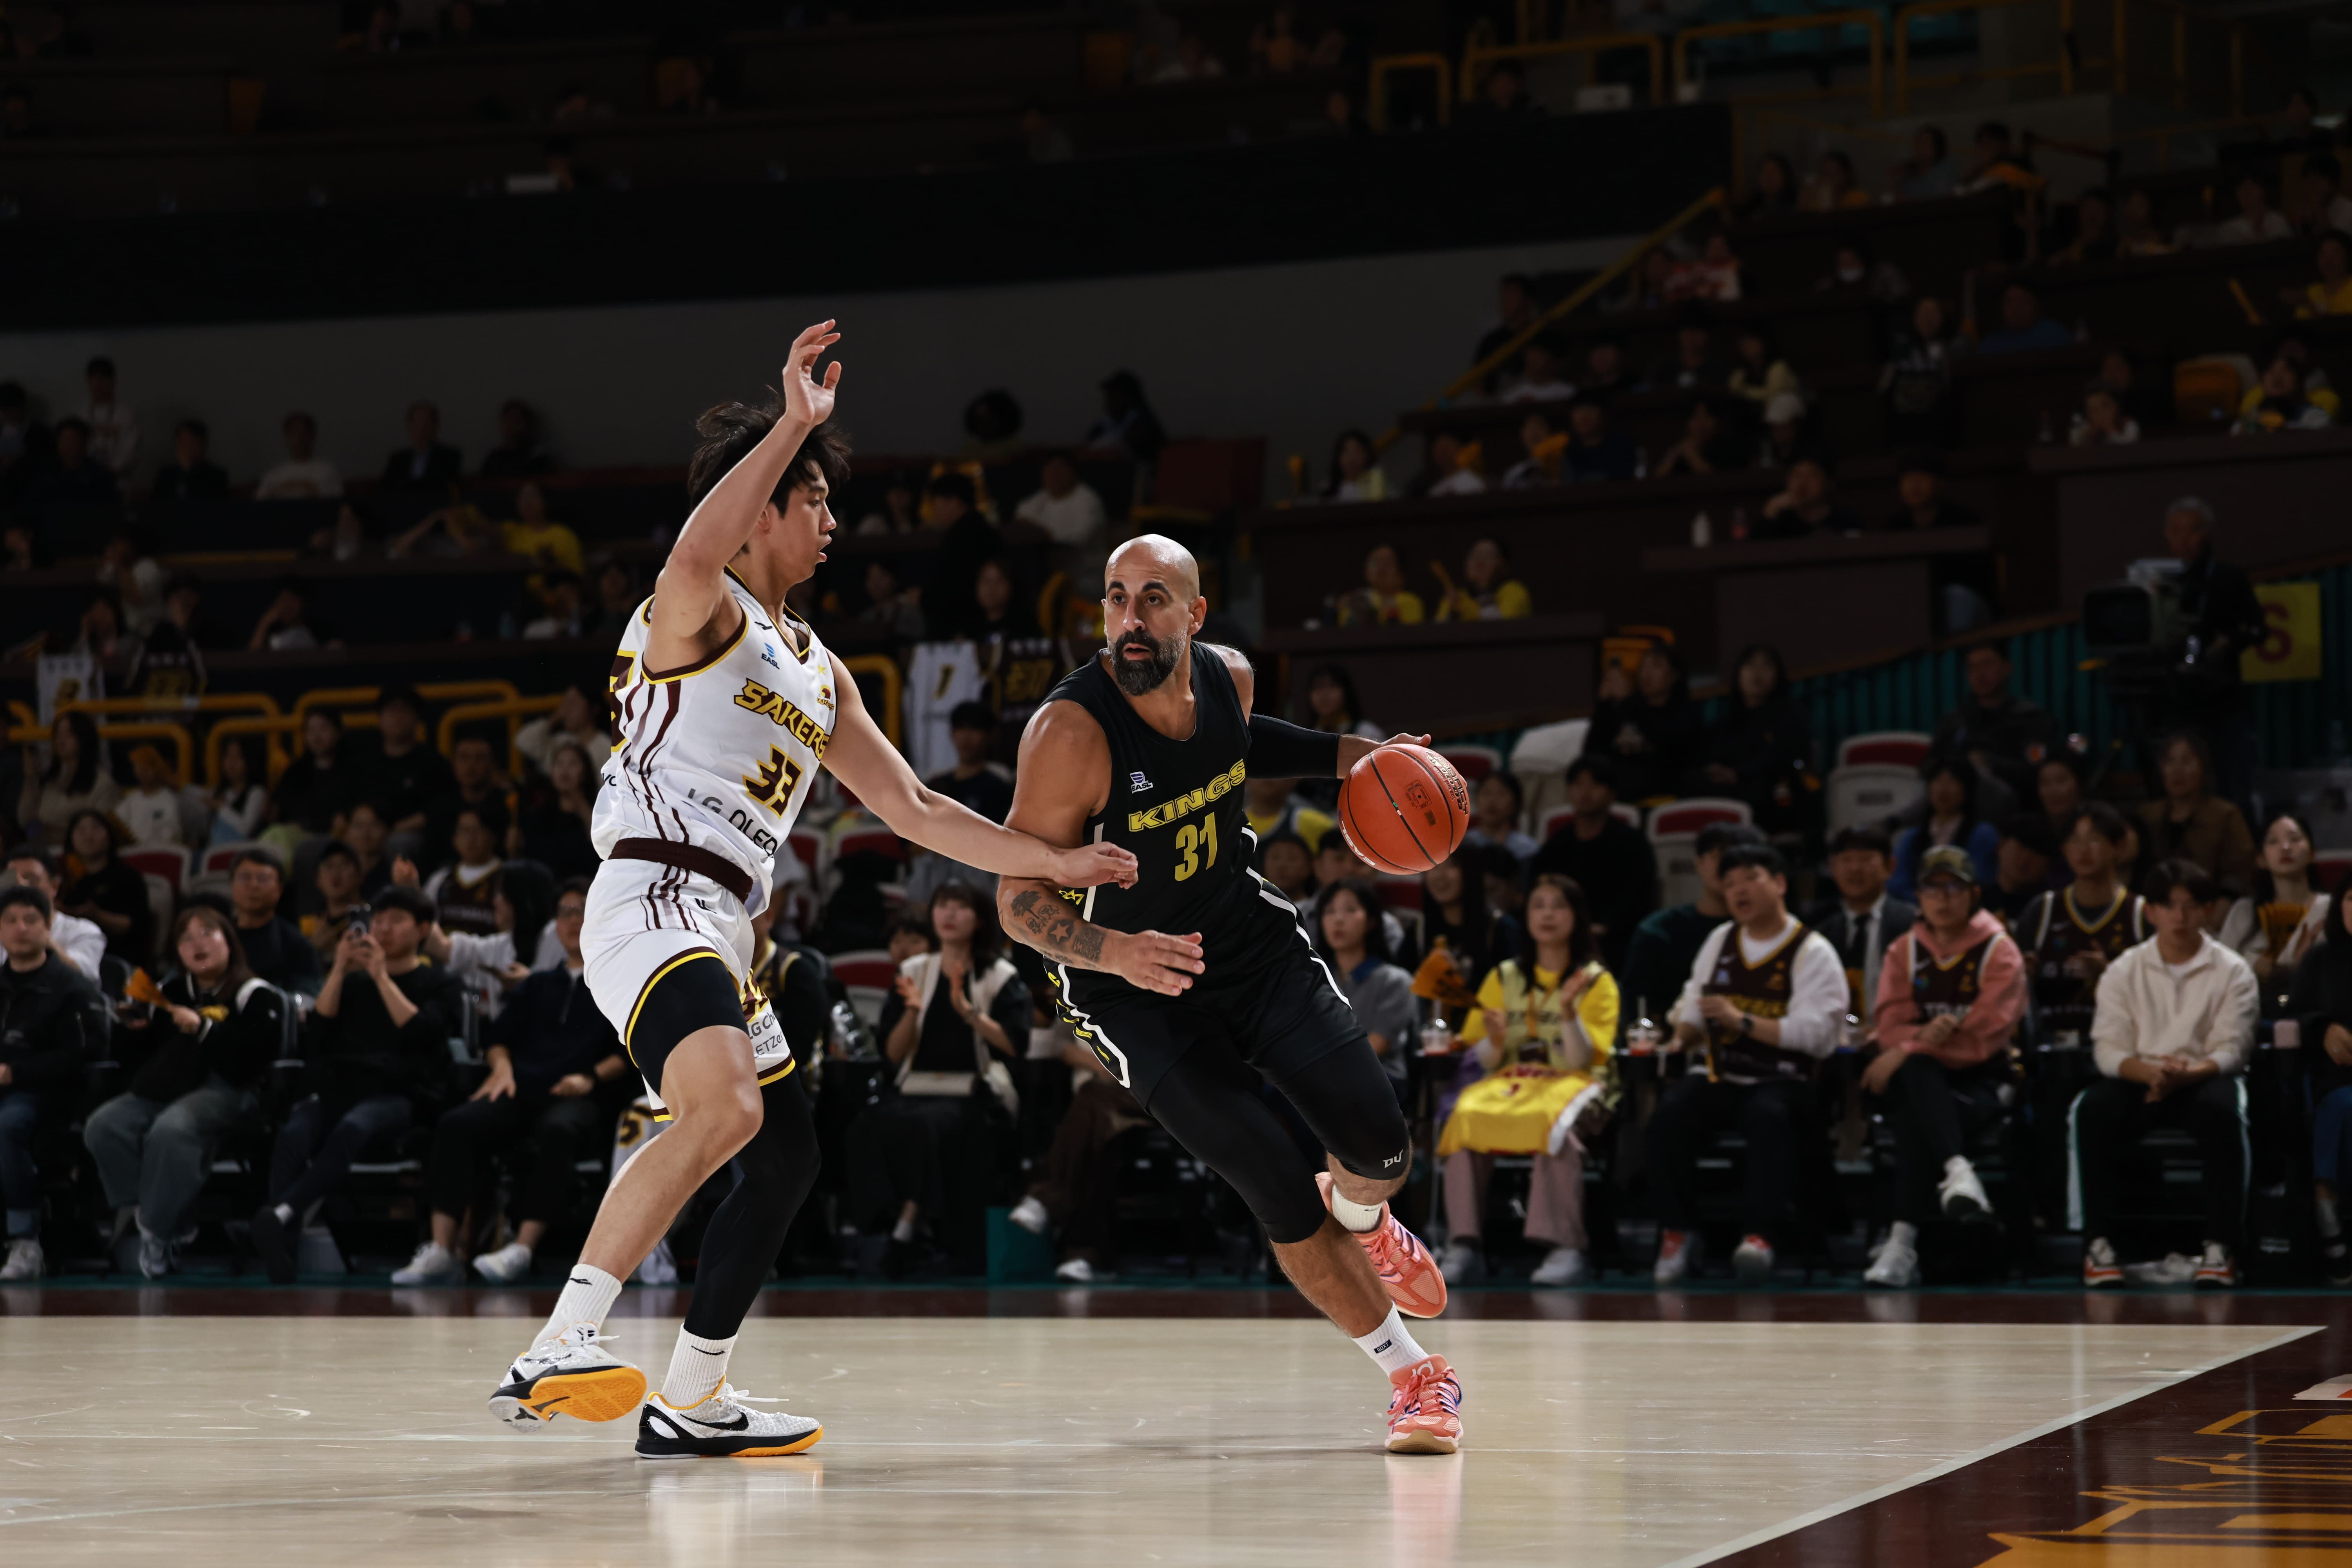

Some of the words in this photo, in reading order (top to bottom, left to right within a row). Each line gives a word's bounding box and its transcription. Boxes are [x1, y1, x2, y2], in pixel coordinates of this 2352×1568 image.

[761, 653, 780, 670] EASL
[734, 677, 830, 762] SAKERS
[742, 742, 804, 820] 33
[1129, 759, 1246, 832] KINGS
[1131, 781, 1152, 793] EASL
[1174, 811, 1218, 882] 31
[1341, 820, 1376, 866] EASL
